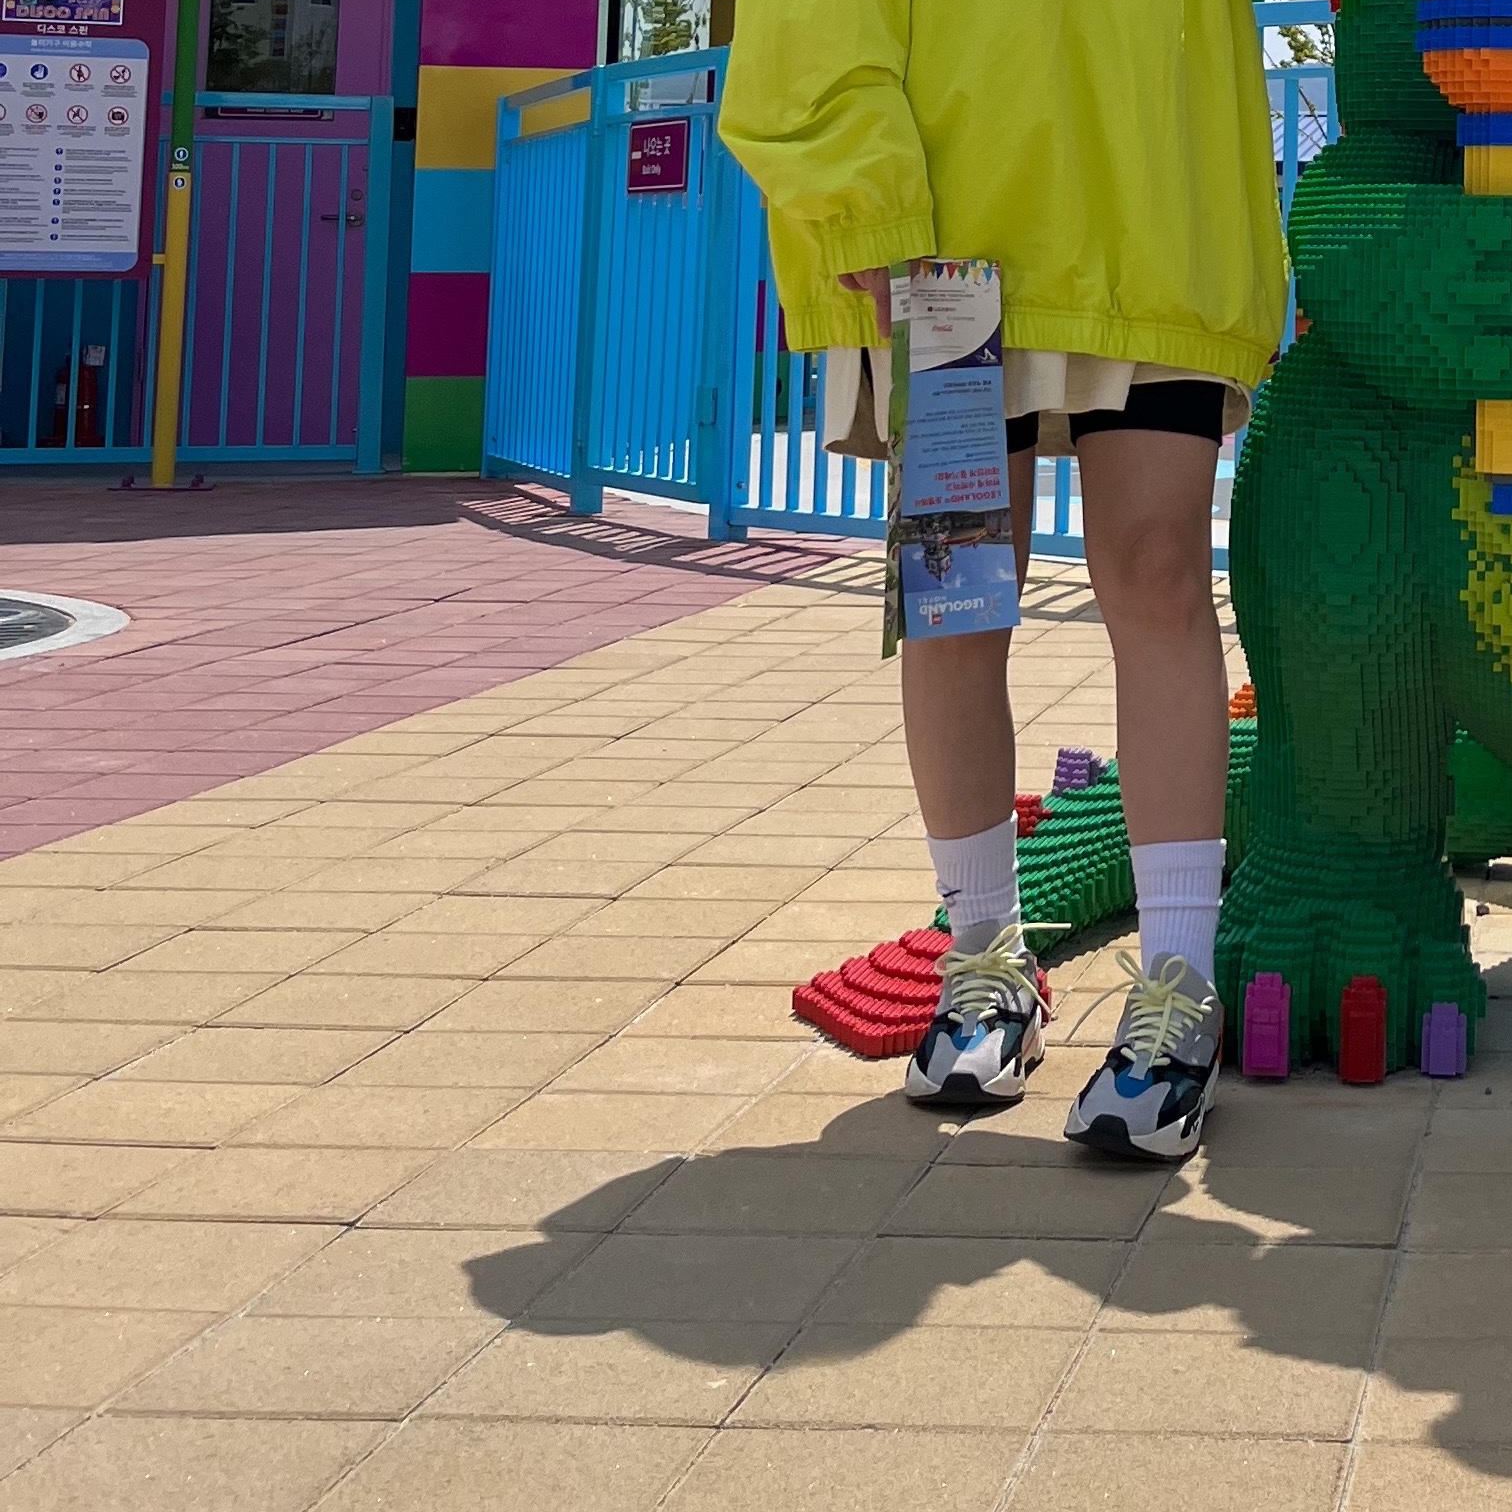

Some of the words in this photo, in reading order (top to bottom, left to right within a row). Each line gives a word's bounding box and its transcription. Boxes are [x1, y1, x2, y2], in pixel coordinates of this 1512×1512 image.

[37, 24, 66, 34] 디스코
[68, 25, 88, 35] 스핀
[643, 137, 663, 156] 나오는
[664, 135, 671, 155] 곳
[919, 597, 985, 619] LEGOLAND
